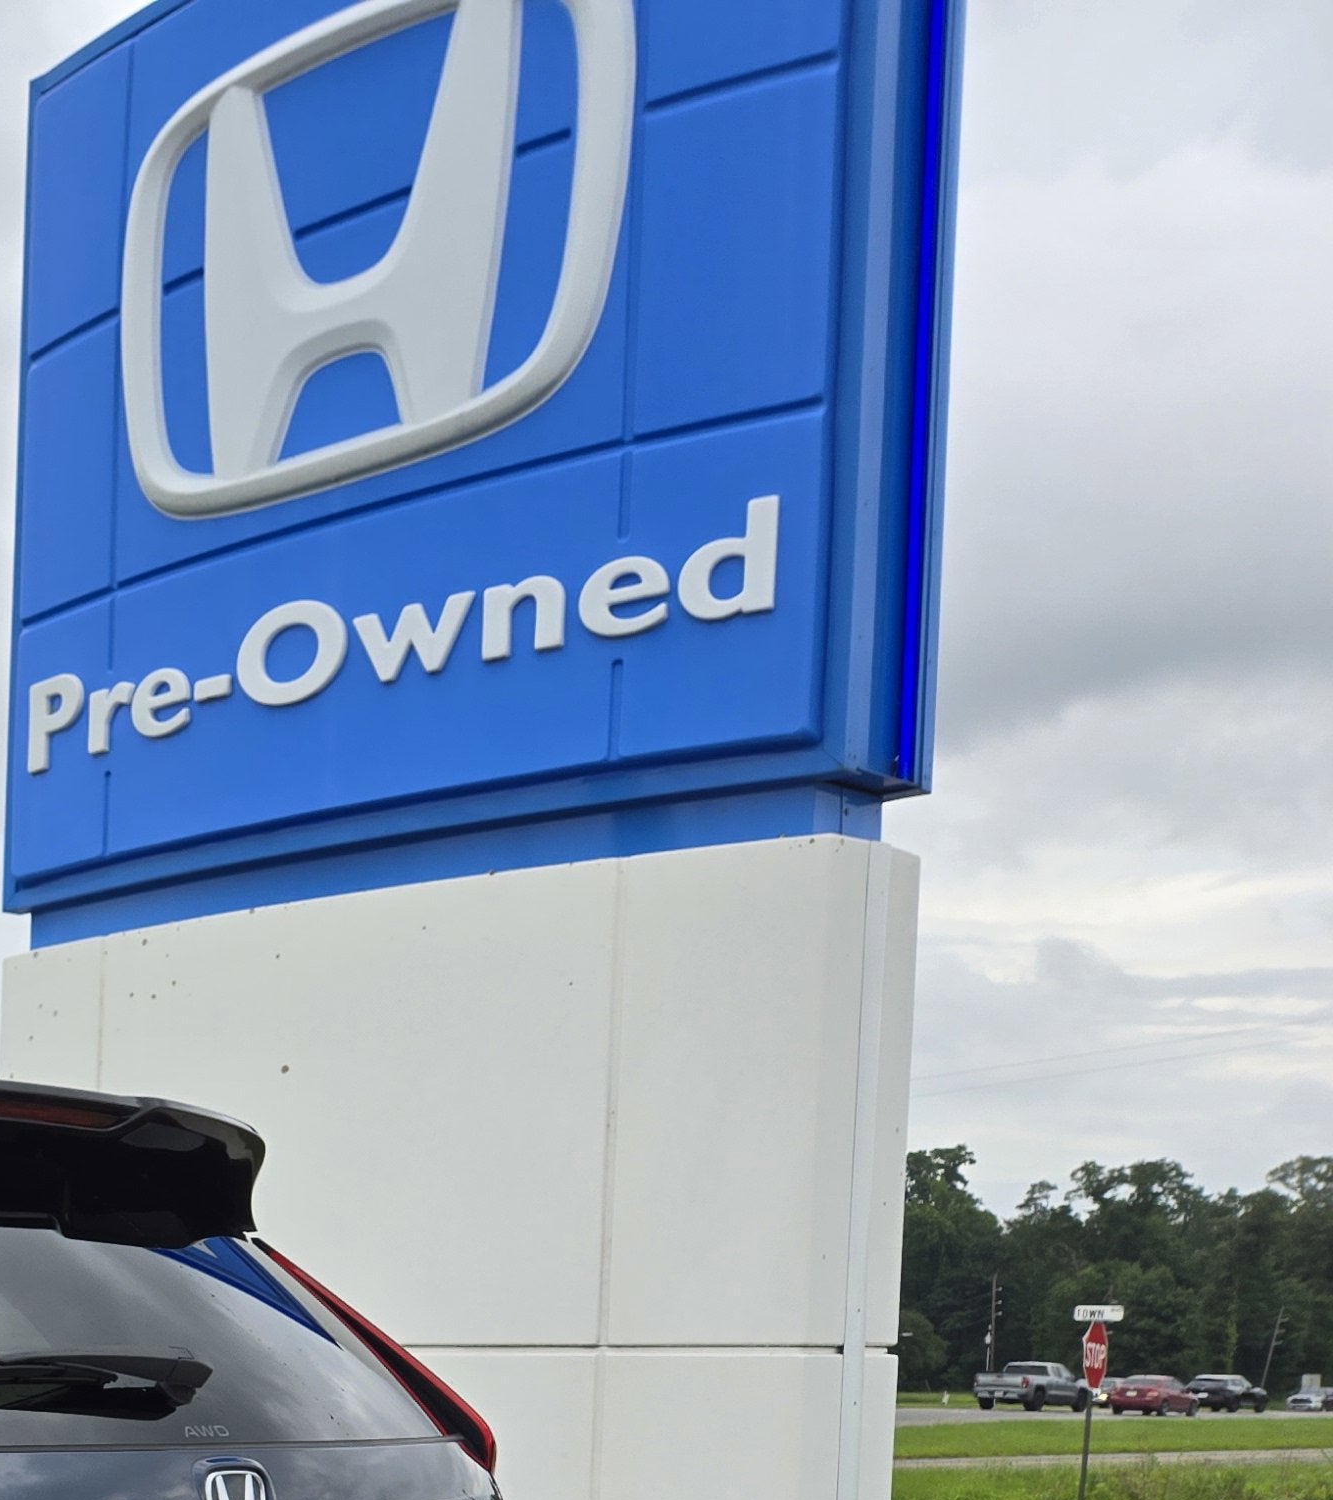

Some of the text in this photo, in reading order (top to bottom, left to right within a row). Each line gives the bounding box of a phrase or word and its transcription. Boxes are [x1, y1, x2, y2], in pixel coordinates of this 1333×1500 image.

[26, 494, 781, 775] Pre-Owned
[1085, 1342, 1106, 1369] STOP
[184, 1425, 230, 1438] AWD
